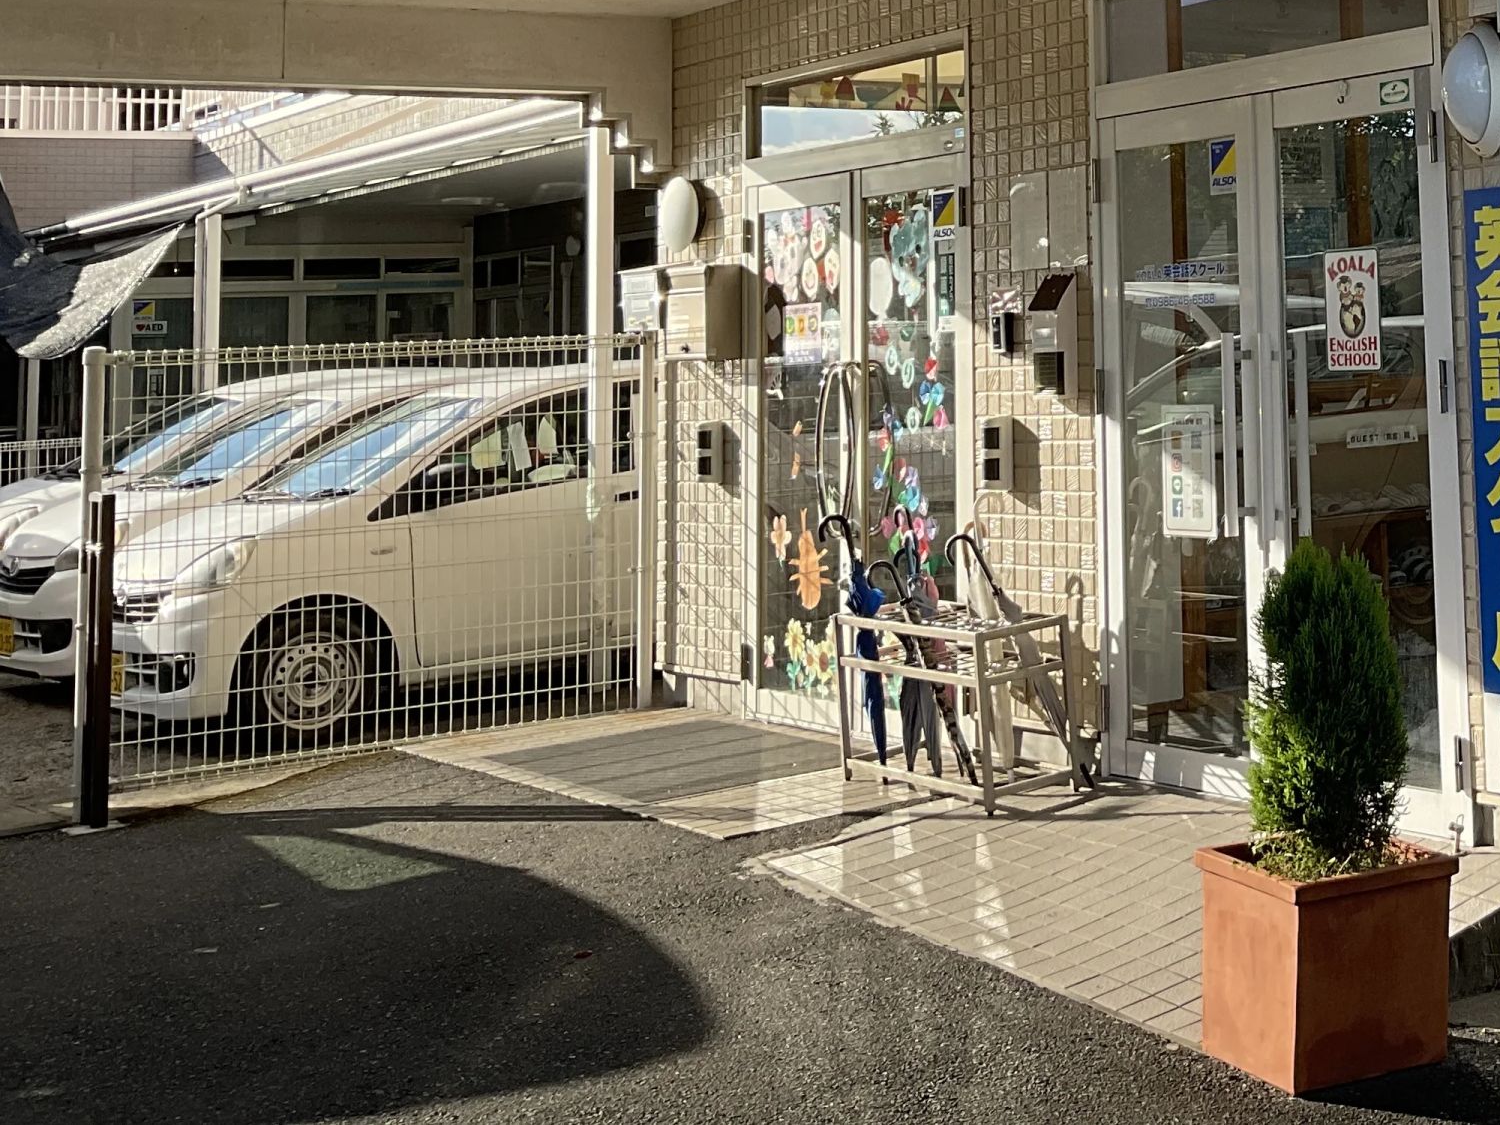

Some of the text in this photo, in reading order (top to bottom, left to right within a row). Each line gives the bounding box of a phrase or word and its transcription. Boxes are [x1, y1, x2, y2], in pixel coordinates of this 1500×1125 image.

[1163, 262, 1225, 278] 英会話スクール
[1327, 256, 1376, 282] KOALA
[145, 324, 164, 332] AED
[1329, 336, 1377, 352] ENGLISH
[1330, 353, 1378, 367] SCHOOL
